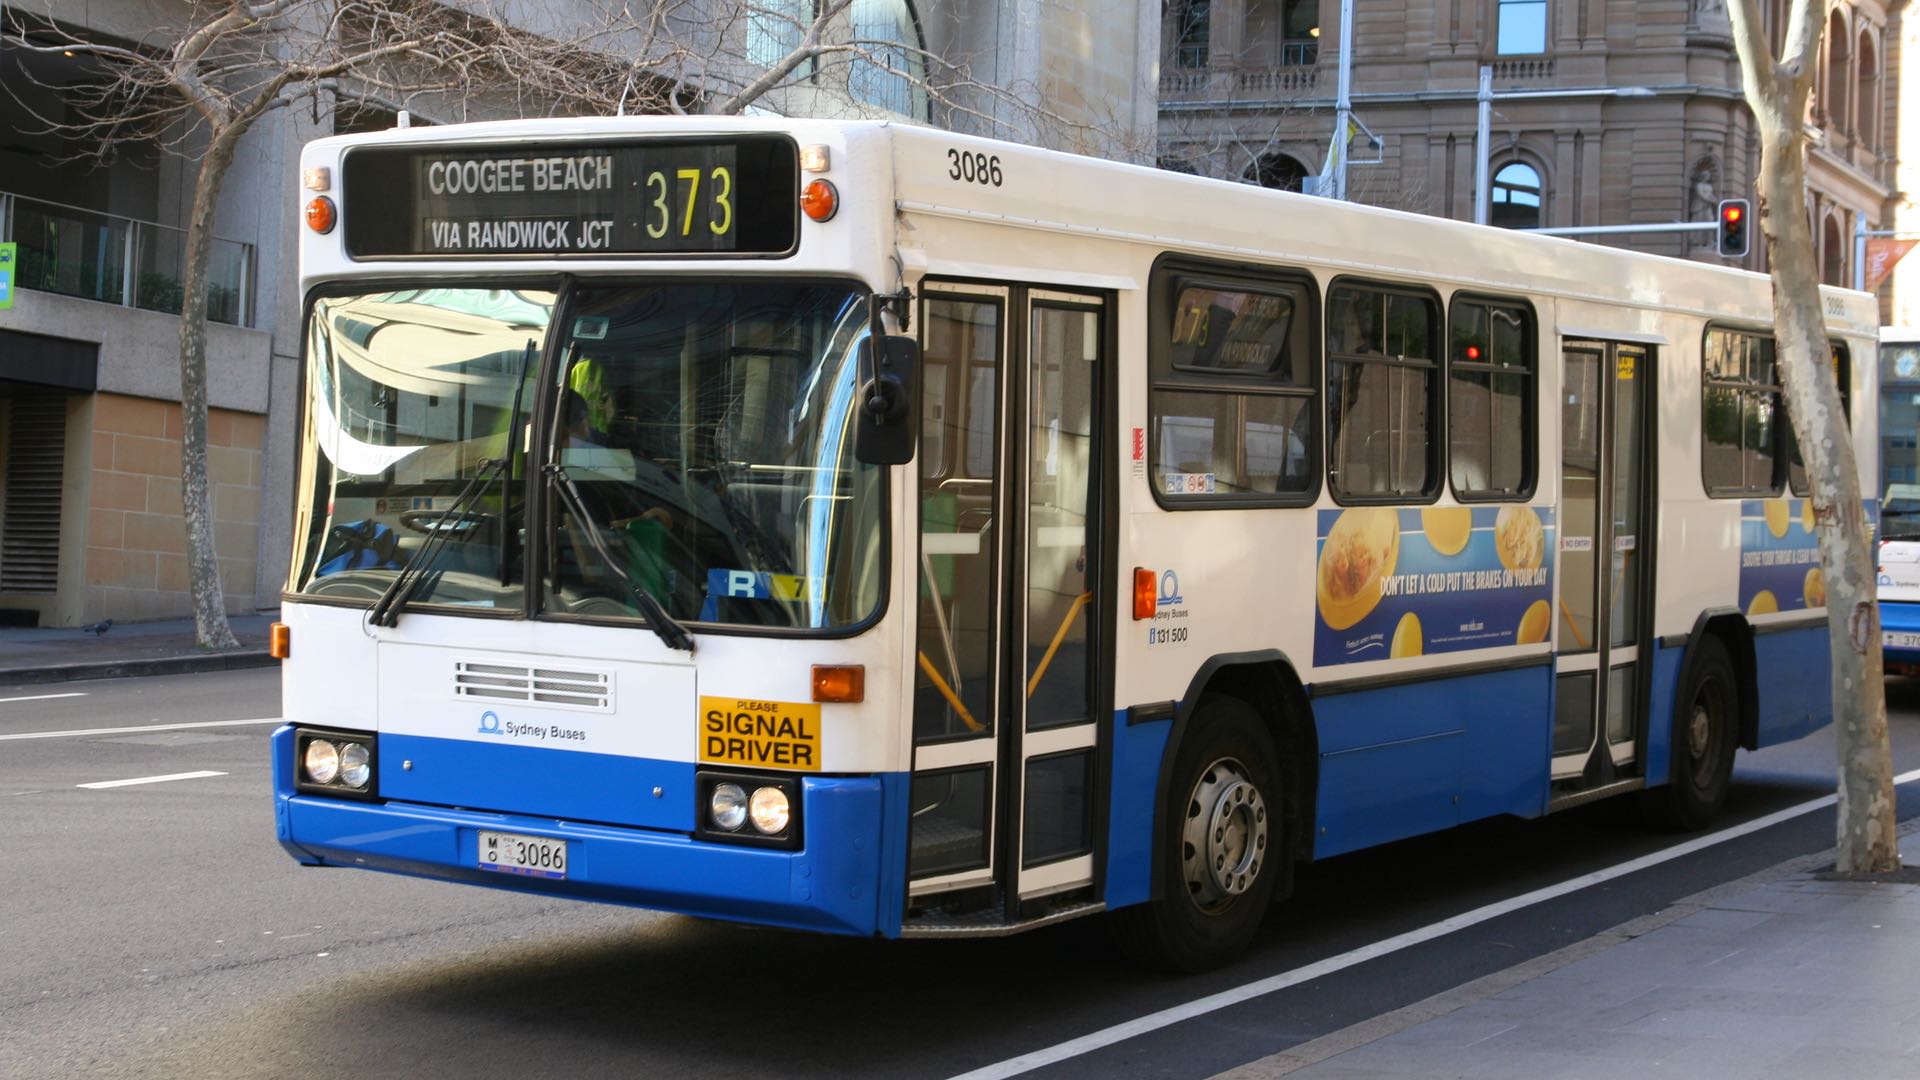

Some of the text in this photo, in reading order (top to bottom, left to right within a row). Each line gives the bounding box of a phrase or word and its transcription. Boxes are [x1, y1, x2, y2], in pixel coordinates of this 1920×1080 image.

[429, 155, 612, 194] COOGEE BEACH
[947, 148, 1002, 187] 3086
[645, 167, 733, 239] 373
[431, 220, 613, 249] VIA RANDWICK JCT
[728, 569, 755, 598] R
[1380, 567, 1547, 596] DON'T LET A COLD PUT THE BRAKES ON YOUR DAY
[1152, 609, 1188, 621] ydney Buses
[1157, 627, 1187, 643] 131 500
[737, 700, 778, 713] PLEASE
[506, 721, 586, 741] Sydney Buses
[706, 712, 814, 740] SIGNAL
[707, 738, 812, 766] DRIVER
[517, 842, 563, 870] 3086
